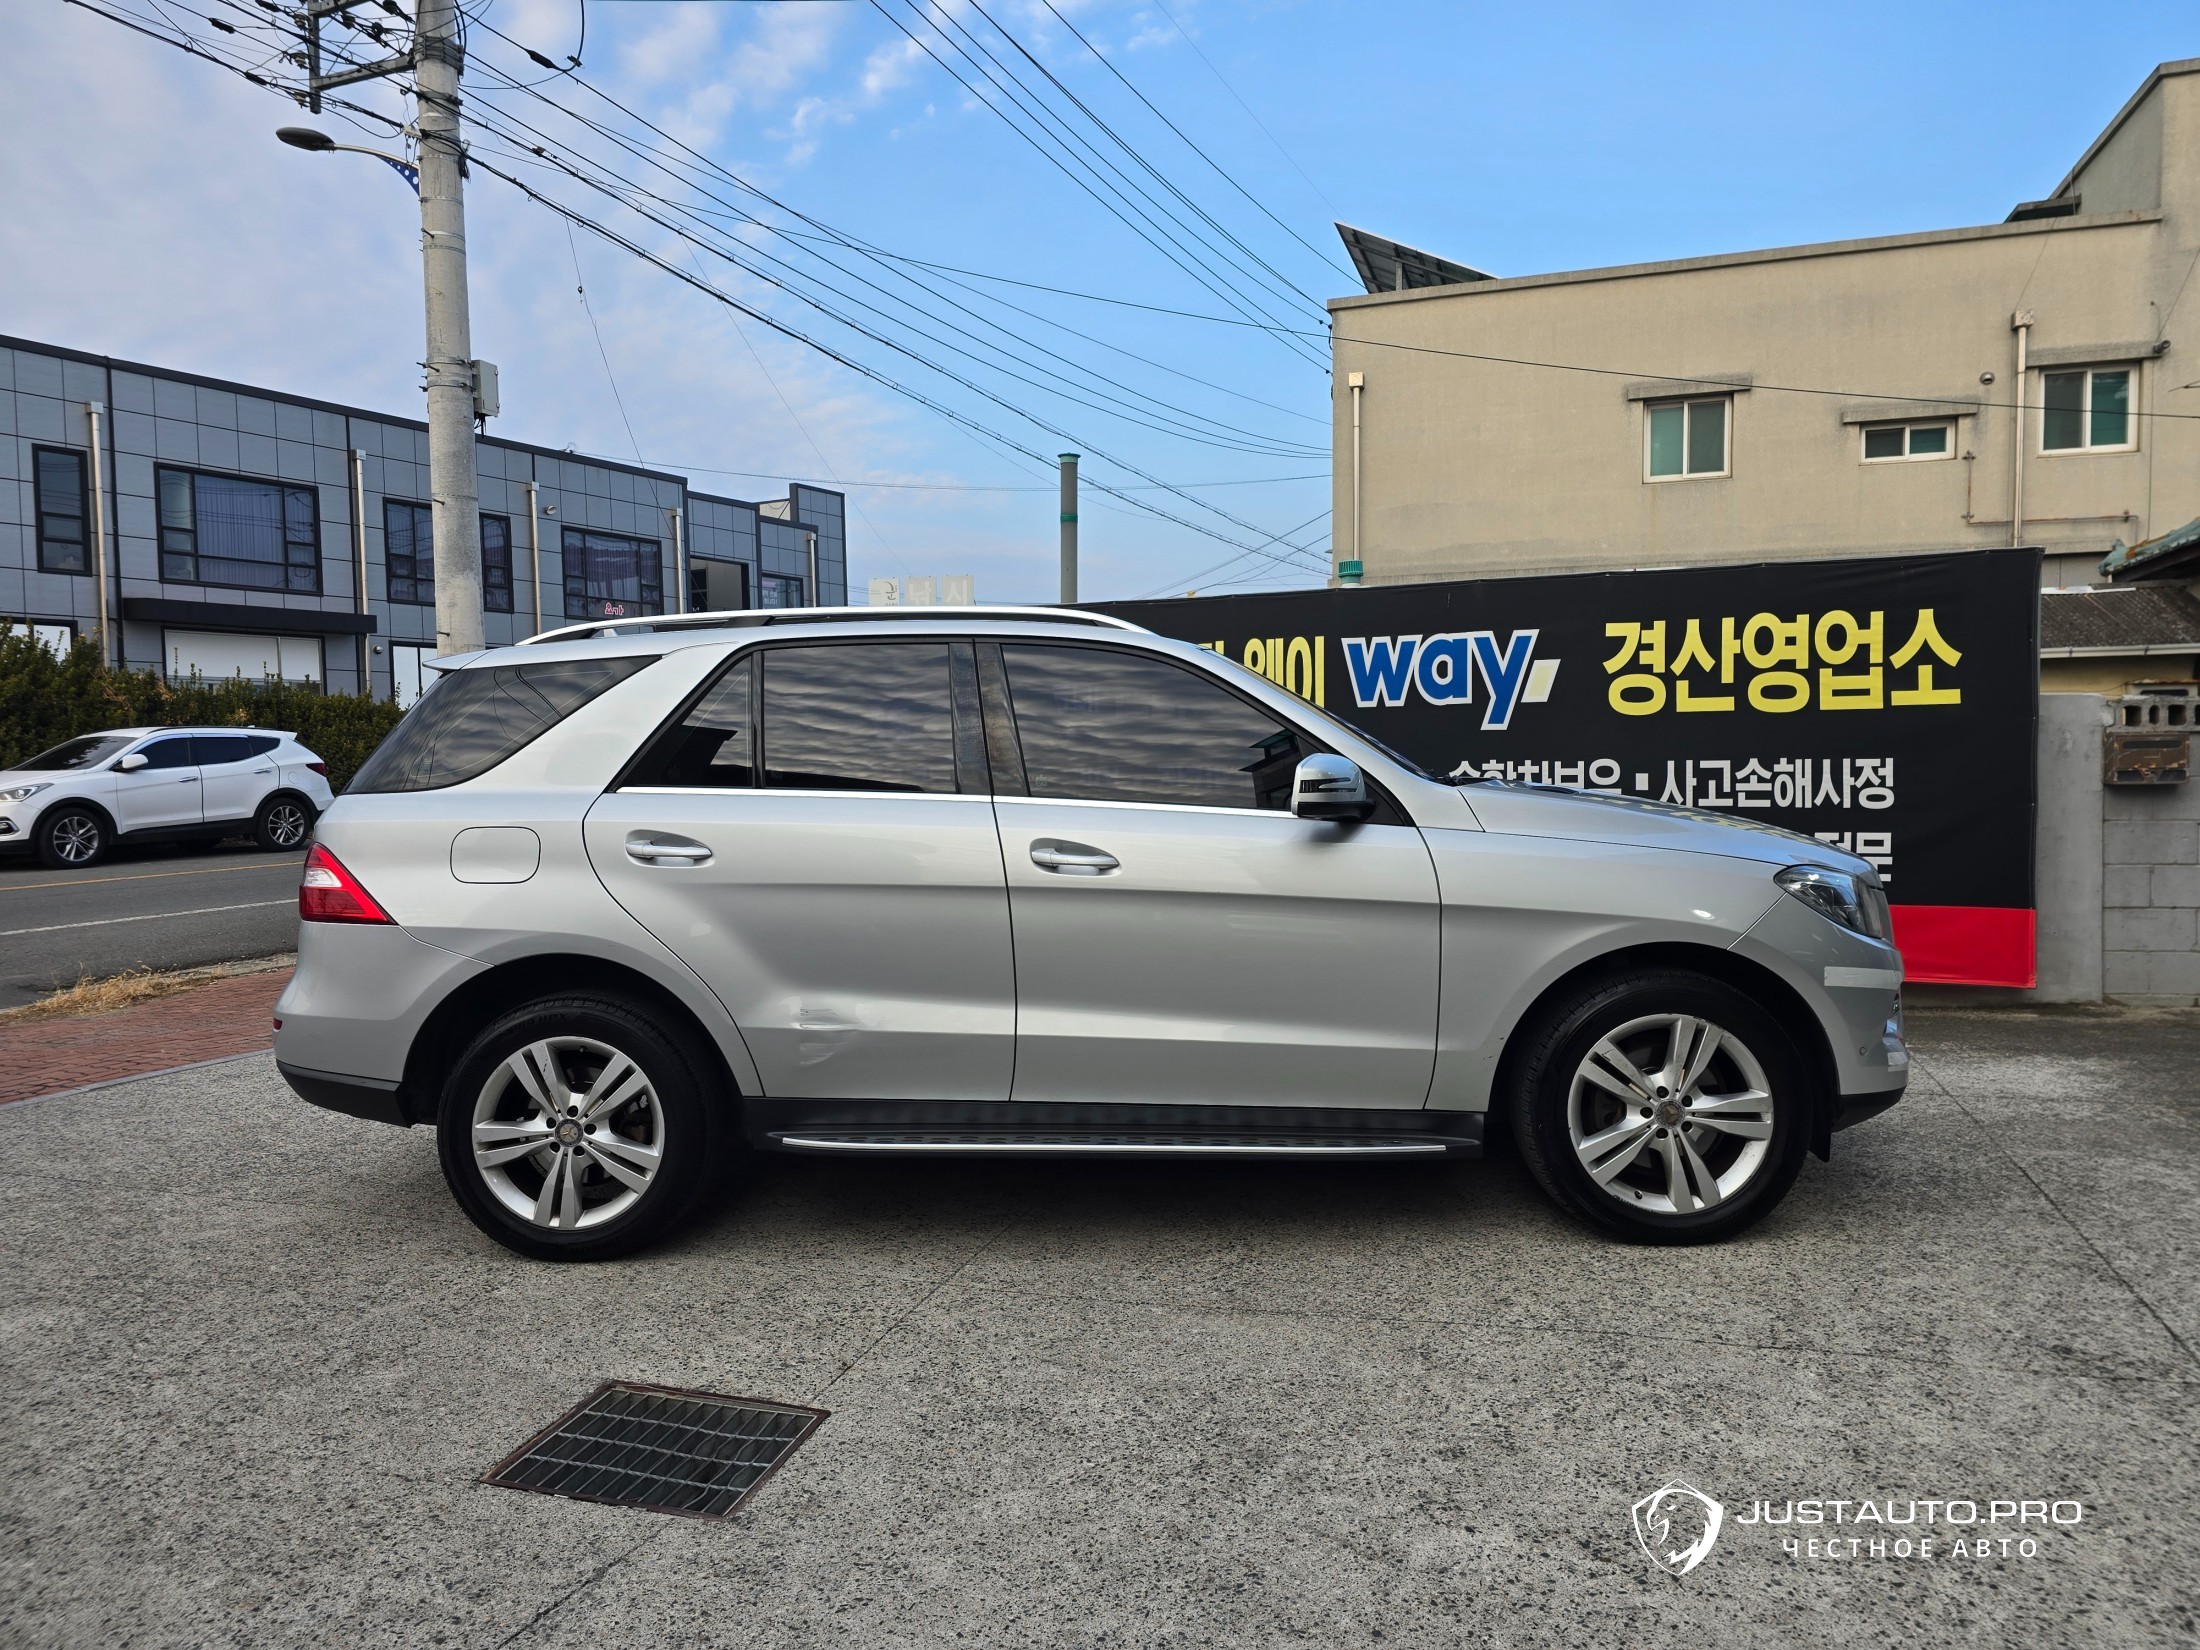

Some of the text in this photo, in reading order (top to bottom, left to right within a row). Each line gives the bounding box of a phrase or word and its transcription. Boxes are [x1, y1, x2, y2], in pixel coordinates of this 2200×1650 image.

[1341, 629, 1539, 730] way
[1603, 609, 1963, 716] 경산영업소
[1659, 757, 1895, 810] 사고손해사정
